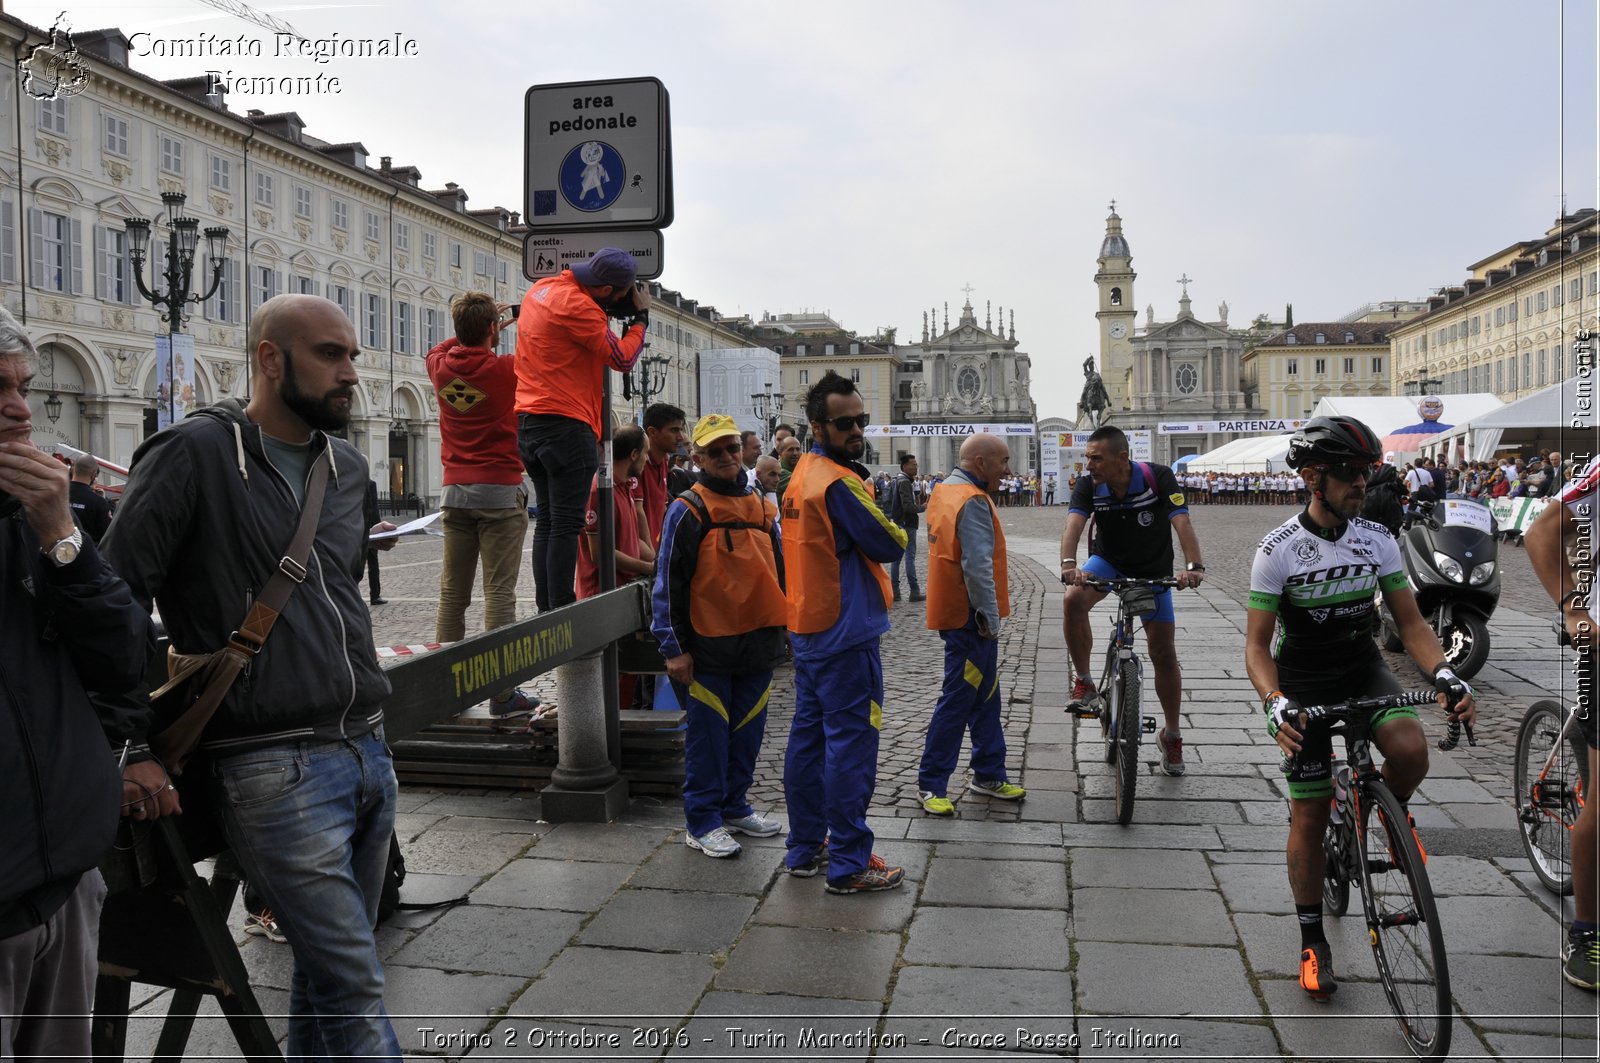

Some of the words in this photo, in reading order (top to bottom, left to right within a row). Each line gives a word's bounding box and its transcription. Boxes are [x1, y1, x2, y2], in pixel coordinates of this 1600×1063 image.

[572, 95, 614, 110] area
[549, 112, 638, 136] pedonale
[533, 237, 564, 246] eccetto:
[561, 249, 586, 259] veicoli
[629, 247, 652, 257] rizzati
[911, 425, 976, 435] PARTENZA
[1218, 420, 1286, 431] PARTENZA
[1262, 522, 1300, 556] aroma
[1286, 563, 1381, 587] SCOTT
[451, 647, 500, 698] TURIN
[503, 620, 573, 677] MARATHON
